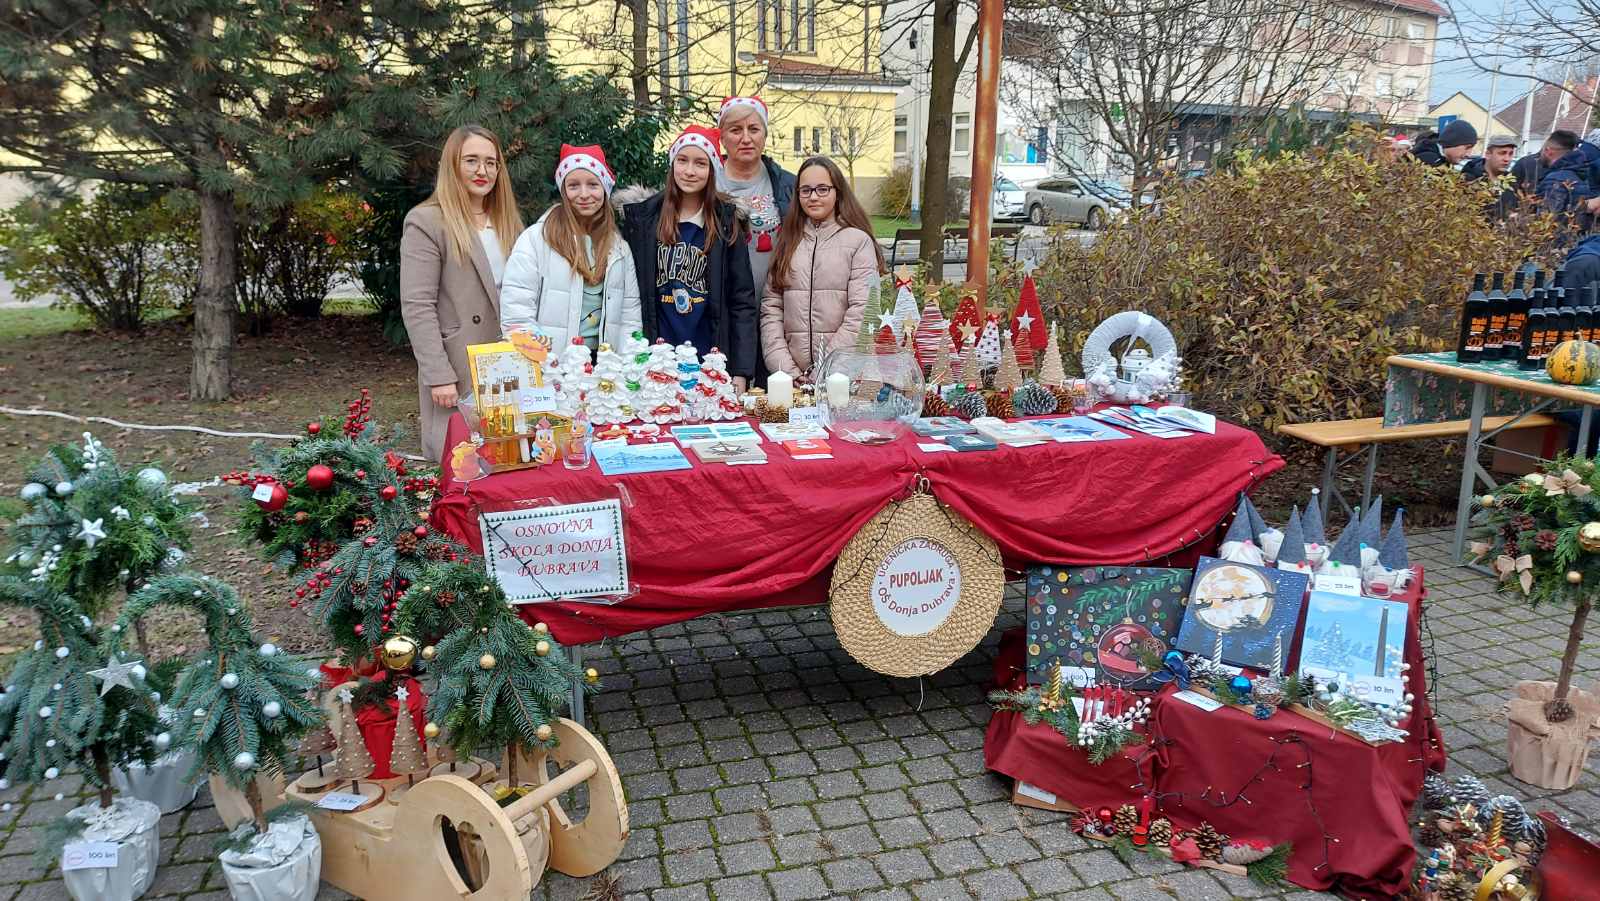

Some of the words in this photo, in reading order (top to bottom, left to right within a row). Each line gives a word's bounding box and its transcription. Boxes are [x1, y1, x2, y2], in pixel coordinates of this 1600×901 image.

[515, 518, 594, 538] OSNOVNA
[558, 537, 613, 554] DONJA
[919, 540, 954, 568] ZADRUGA
[518, 560, 600, 577] DUBRAVA
[889, 568, 943, 588] PUPOLJAK
[878, 587, 891, 603] OŠ
[888, 600, 918, 617] Donja
[921, 578, 956, 613] Dubrava
